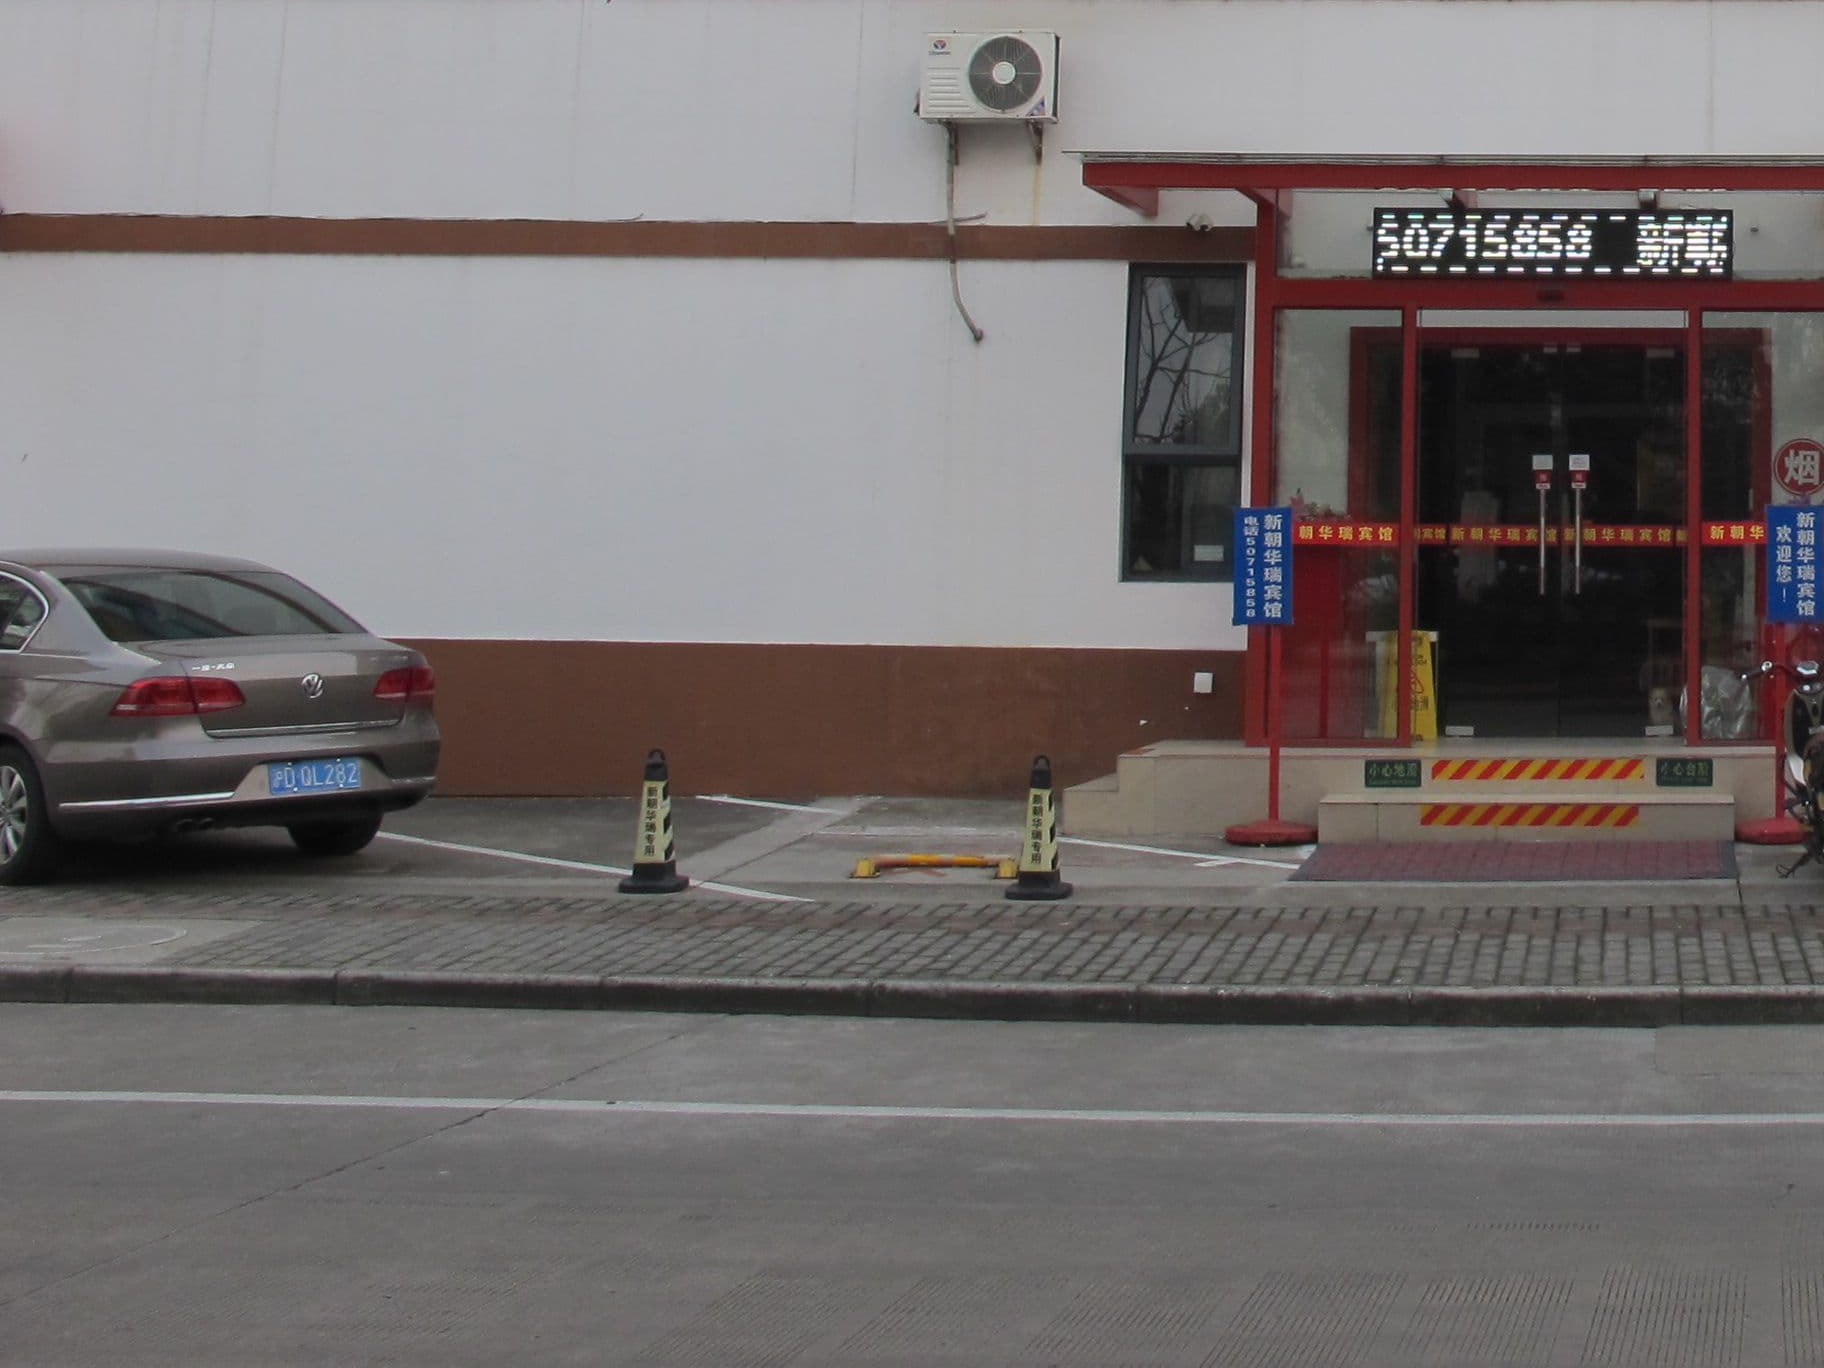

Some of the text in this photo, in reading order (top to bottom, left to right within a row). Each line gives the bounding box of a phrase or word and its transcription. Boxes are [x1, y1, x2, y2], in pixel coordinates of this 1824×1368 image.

[1784, 449, 1821, 485] 烟
[1263, 514, 1282, 618] 新朝华瑞宾馆
[1710, 525, 1764, 540] 新朝华
[1797, 511, 1816, 617] 新朝华瑞宾馆
